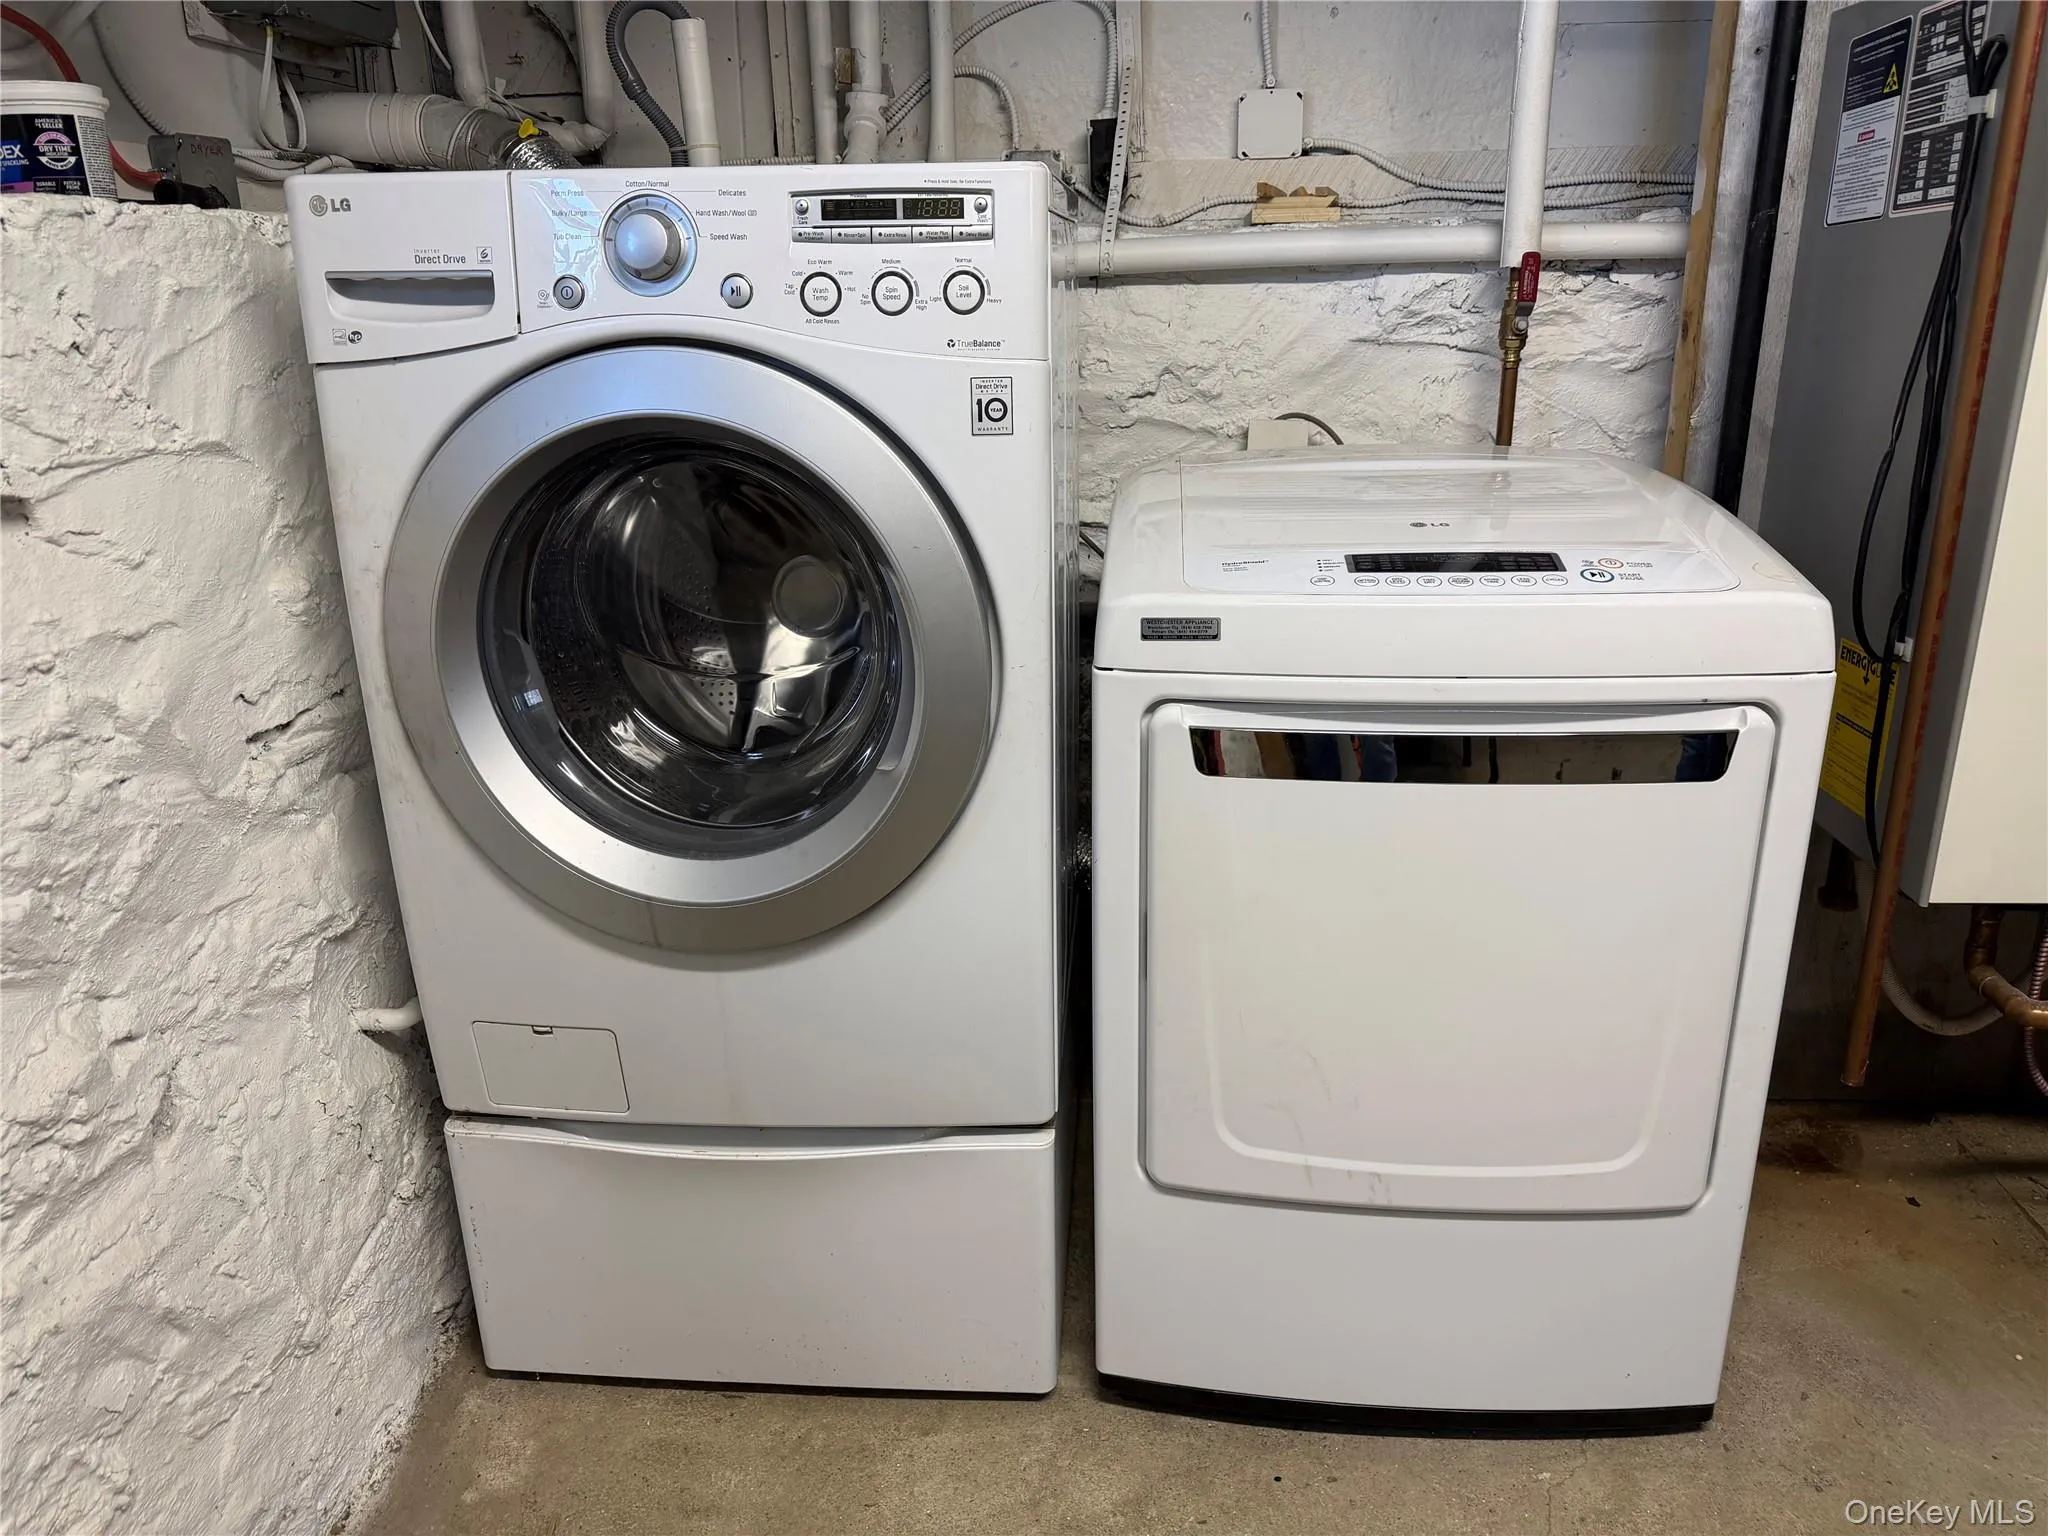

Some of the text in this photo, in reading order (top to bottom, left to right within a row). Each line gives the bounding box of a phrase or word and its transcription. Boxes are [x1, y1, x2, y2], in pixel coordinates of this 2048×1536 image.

[191, 141, 224, 158] DRYER
[625, 180, 670, 188] Cotton/Normal
[330, 198, 351, 212] LG
[710, 233, 727, 241] Speed
[415, 254, 466, 264] Direct Drive
[885, 286, 898, 294] Spin
[976, 398, 1008, 422] 10
